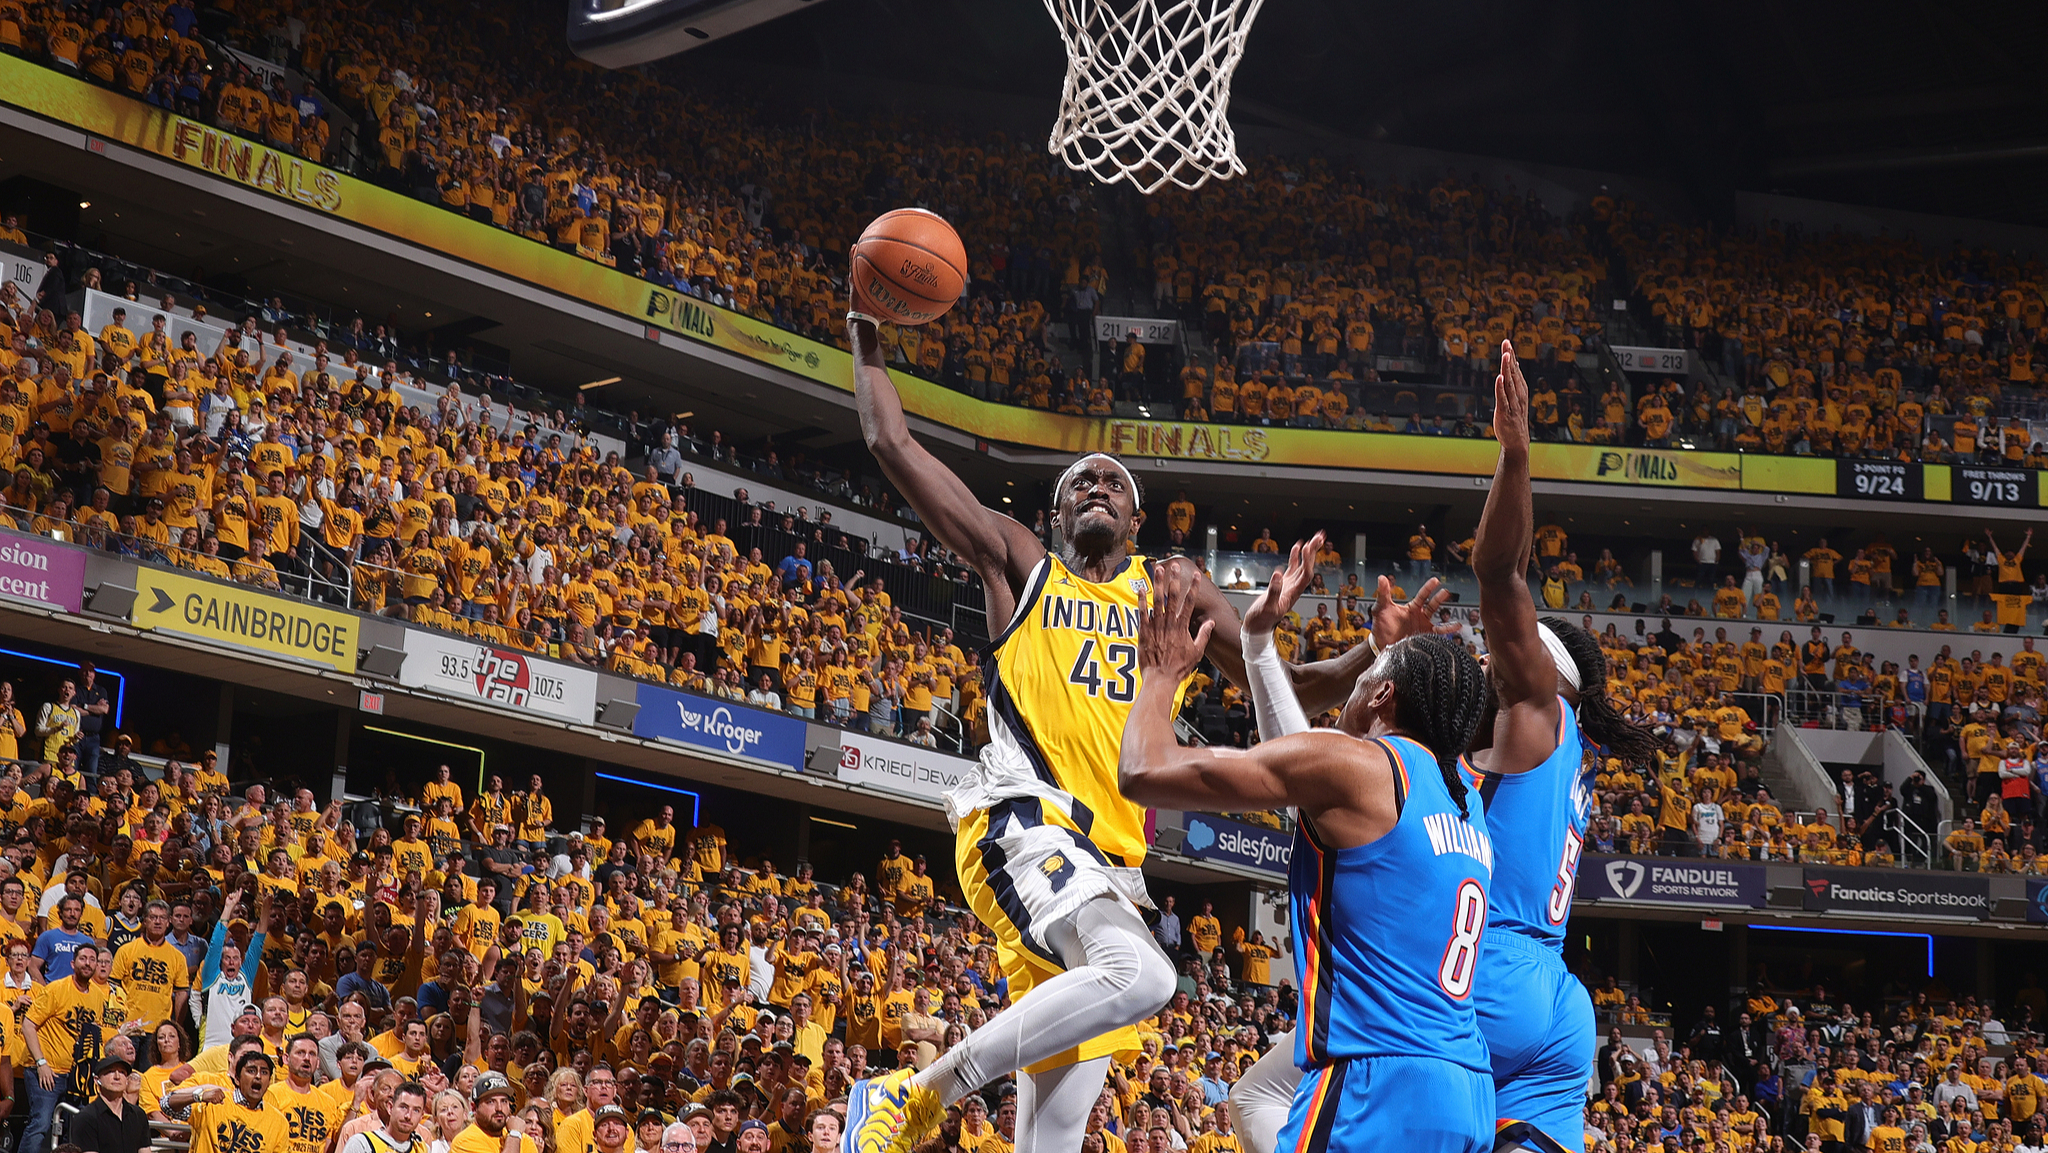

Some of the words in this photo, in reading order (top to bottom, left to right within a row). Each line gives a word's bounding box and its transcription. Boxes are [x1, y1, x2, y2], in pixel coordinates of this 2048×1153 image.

[173, 118, 342, 211] FINALS
[14, 262, 33, 285] 106
[902, 264, 938, 288] Finals
[868, 277, 937, 320] Wilson
[1102, 323, 1120, 337] 211
[1149, 325, 1170, 340] 212
[1662, 354, 1683, 369] 213
[1111, 420, 1270, 461] FINALS
[1853, 463, 1891, 474] 3-POINT
[1962, 469, 1986, 479] FREE
[1988, 470, 2027, 482] THROWS
[1855, 475, 1905, 495] 9/24
[1970, 481, 2020, 502] 9/13
[0, 542, 48, 571] sion
[0, 575, 50, 600] cent
[183, 592, 347, 657] GAINBRIDGE
[1042, 594, 1153, 638] INDIAN
[441, 655, 469, 679] 93.5
[471, 646, 519, 682] the
[1069, 639, 1138, 702] 43
[480, 673, 530, 708] fan
[534, 677, 563, 700] 107.5
[364, 694, 380, 711] EXIT
[61, 727, 69, 736] 5
[703, 707, 762, 754] Kroger
[863, 754, 912, 777] KRIEG
[1549, 824, 1584, 926] 5
[1652, 867, 1739, 886] FANDUEL
[1652, 884, 1690, 896] SPORTS
[1691, 886, 1739, 898] NETWORK
[1831, 884, 1896, 902] Fanatics
[1897, 888, 1987, 907] Sportsbook
[80, 922, 94, 933] ES
[479, 918, 493, 930] YES
[527, 921, 547, 930] YES
[522, 929, 549, 941] CERS
[1437, 877, 1488, 1000] 8
[54, 942, 71, 953] Rad
[140, 956, 168, 973] YES
[723, 963, 740, 975] YES
[135, 983, 147, 992] 2025
[148, 985, 161, 993] FINALS
[217, 983, 245, 996] INDY
[827, 981, 841, 992] YES
[73, 1005, 96, 1022] YES
[887, 1009, 902, 1017] CE
[892, 1001, 908, 1011] YES
[65, 1019, 81, 1032] CE
[731, 1017, 746, 1027] YES
[293, 1106, 325, 1126] YES
[228, 1119, 264, 1149] YES
[292, 1142, 306, 1151] 2025
